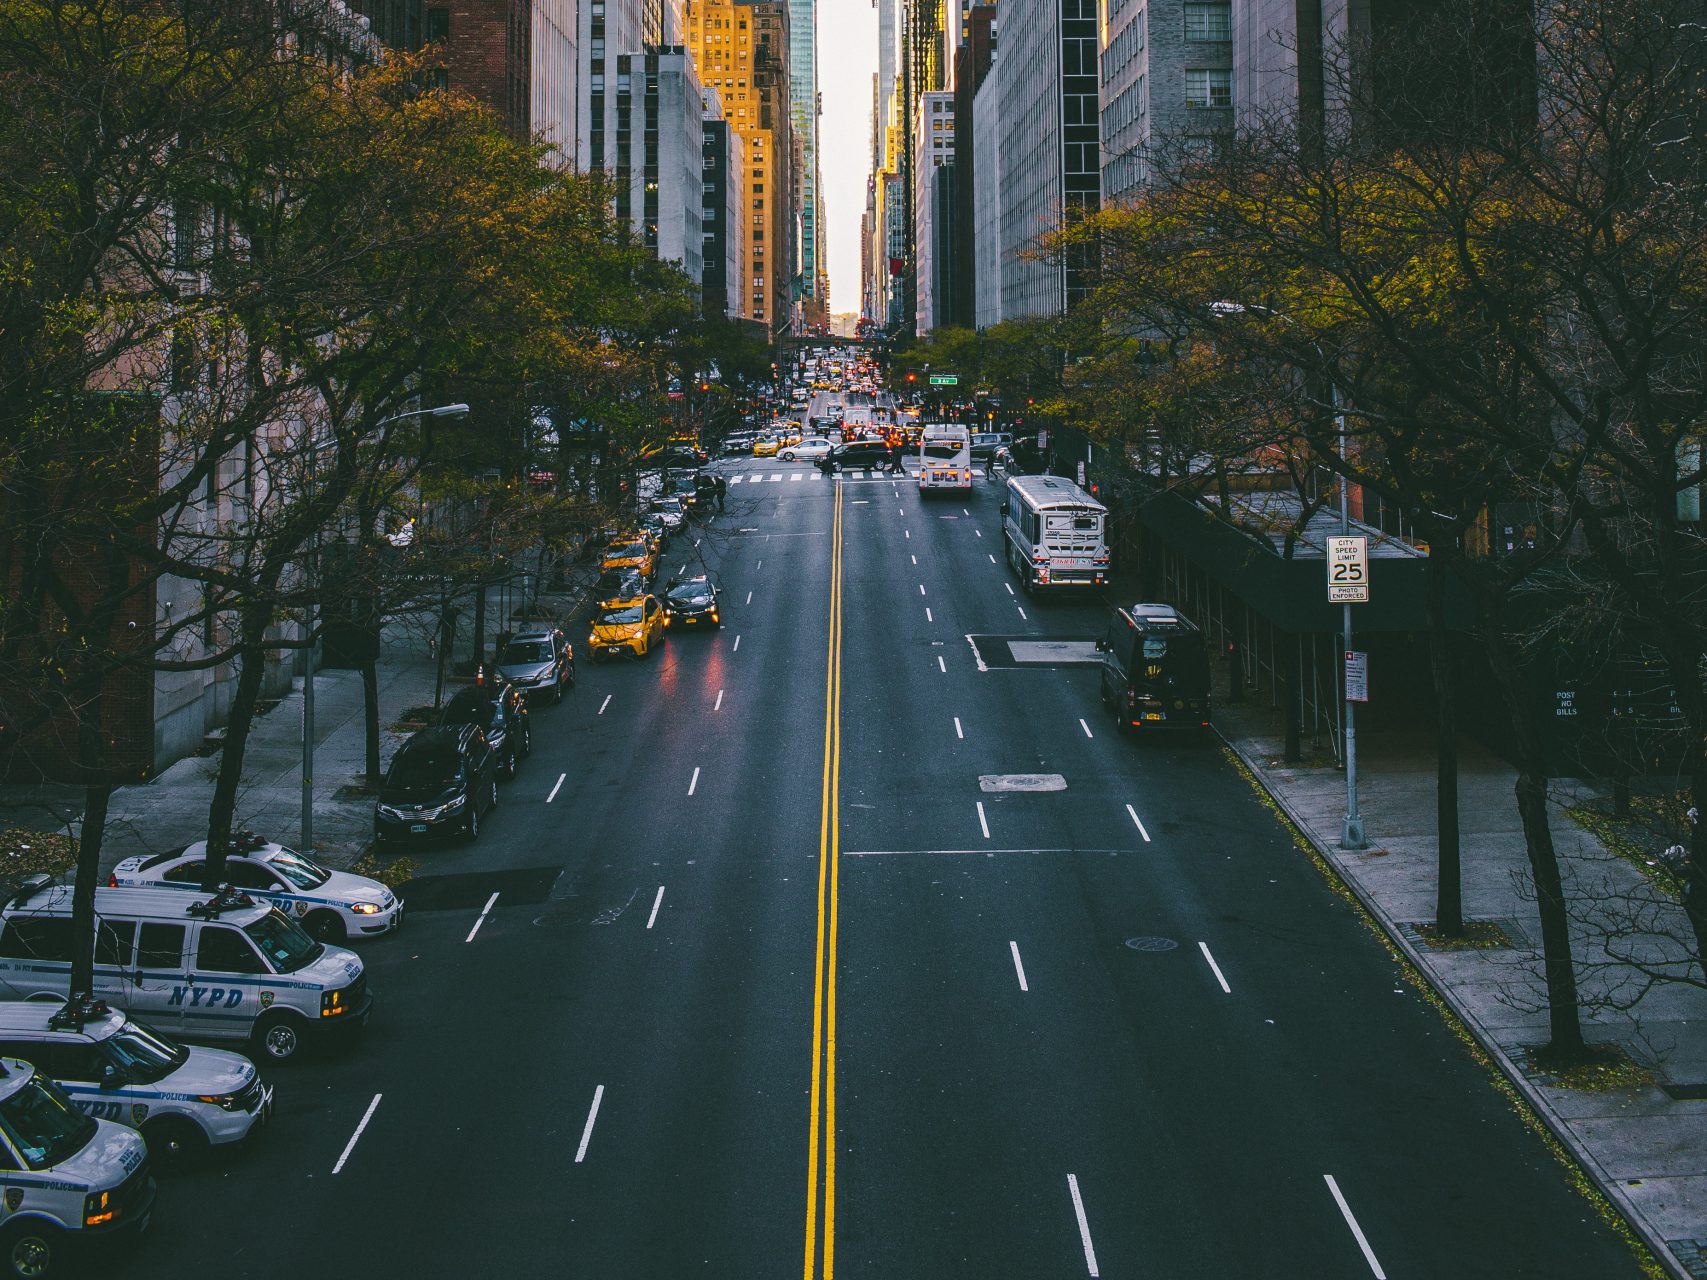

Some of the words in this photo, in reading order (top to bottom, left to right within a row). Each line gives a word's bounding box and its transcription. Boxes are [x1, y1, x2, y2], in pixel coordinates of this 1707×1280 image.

[1334, 563, 1363, 581] 25
[1556, 708, 1577, 716] BILLS
[289, 982, 311, 990] POLICE
[167, 986, 243, 1009] NYPD
[161, 1092, 188, 1102] POLICE
[123, 1152, 142, 1176] POLICE
[45, 1181, 74, 1190] POLICE
